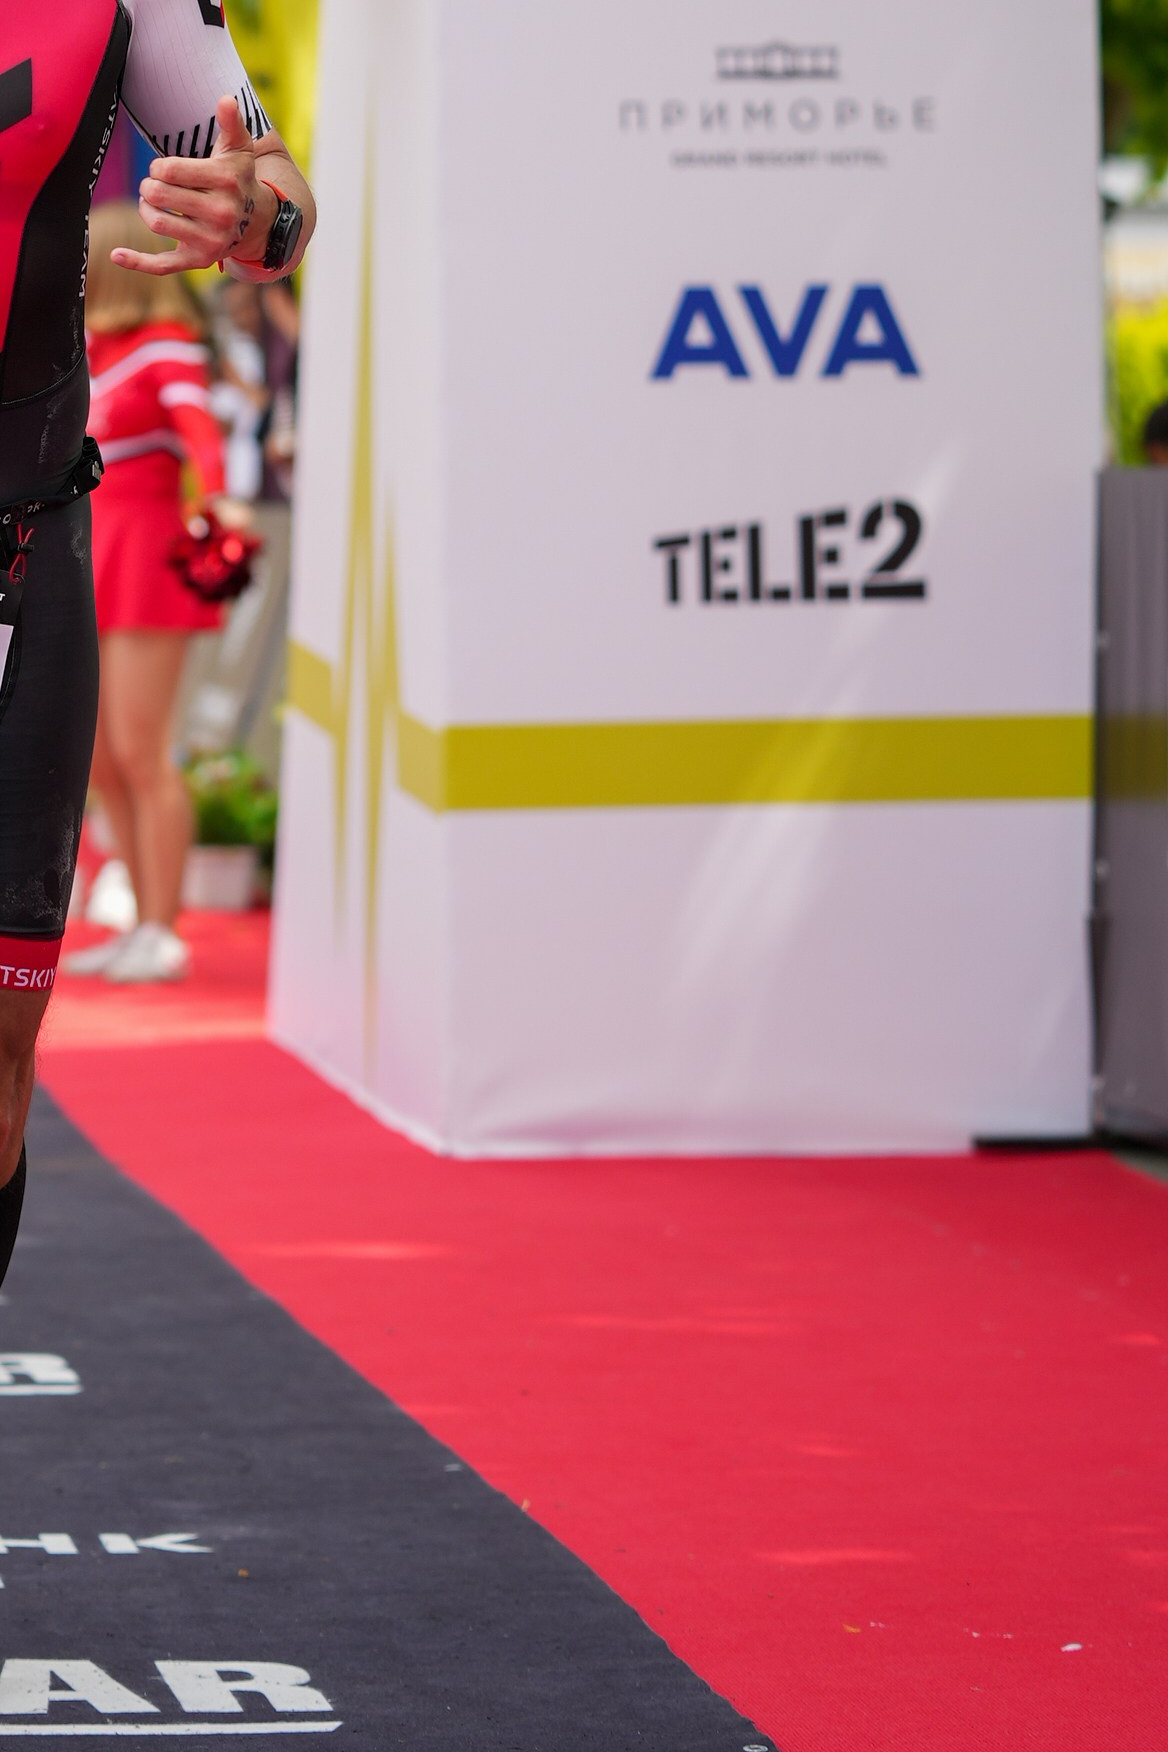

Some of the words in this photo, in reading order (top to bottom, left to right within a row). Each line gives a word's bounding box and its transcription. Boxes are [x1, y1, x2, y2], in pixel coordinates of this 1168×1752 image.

[620, 98, 938, 134] ПРИМОРЬЕ
[651, 285, 921, 381] AVA
[654, 500, 927, 606] TELE2
